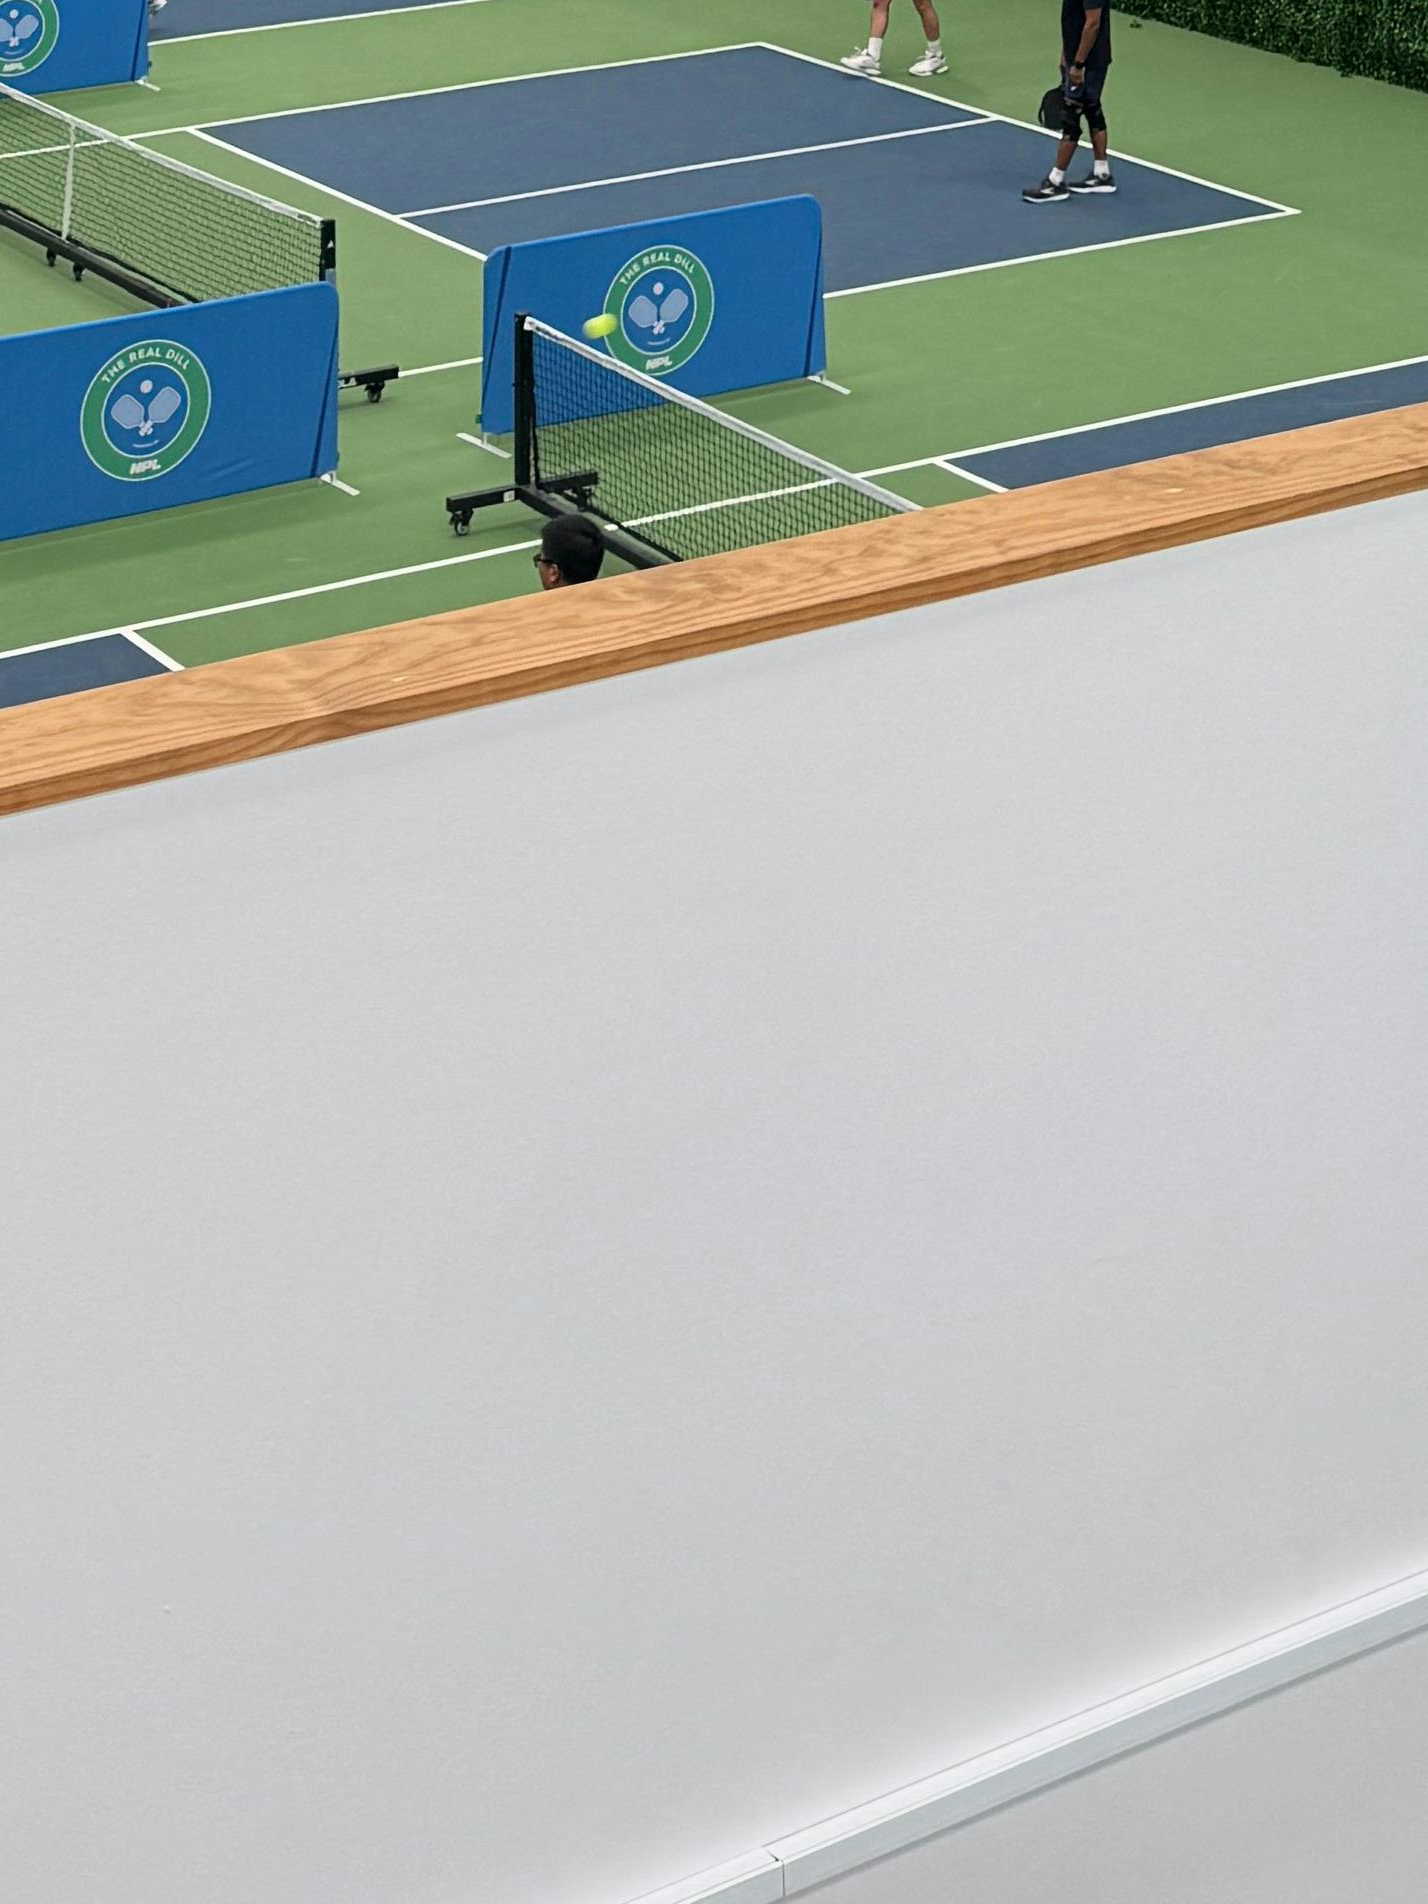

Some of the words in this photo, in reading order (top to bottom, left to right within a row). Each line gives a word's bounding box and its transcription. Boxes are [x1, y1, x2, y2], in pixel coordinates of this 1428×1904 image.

[619, 262, 641, 285] THE
[642, 252, 670, 267] REAL
[674, 253, 695, 274] DILL
[101, 359, 125, 383] THE
[128, 346, 162, 363] REAL
[165, 348, 190, 370] DILL
[129, 458, 162, 475] NPL
